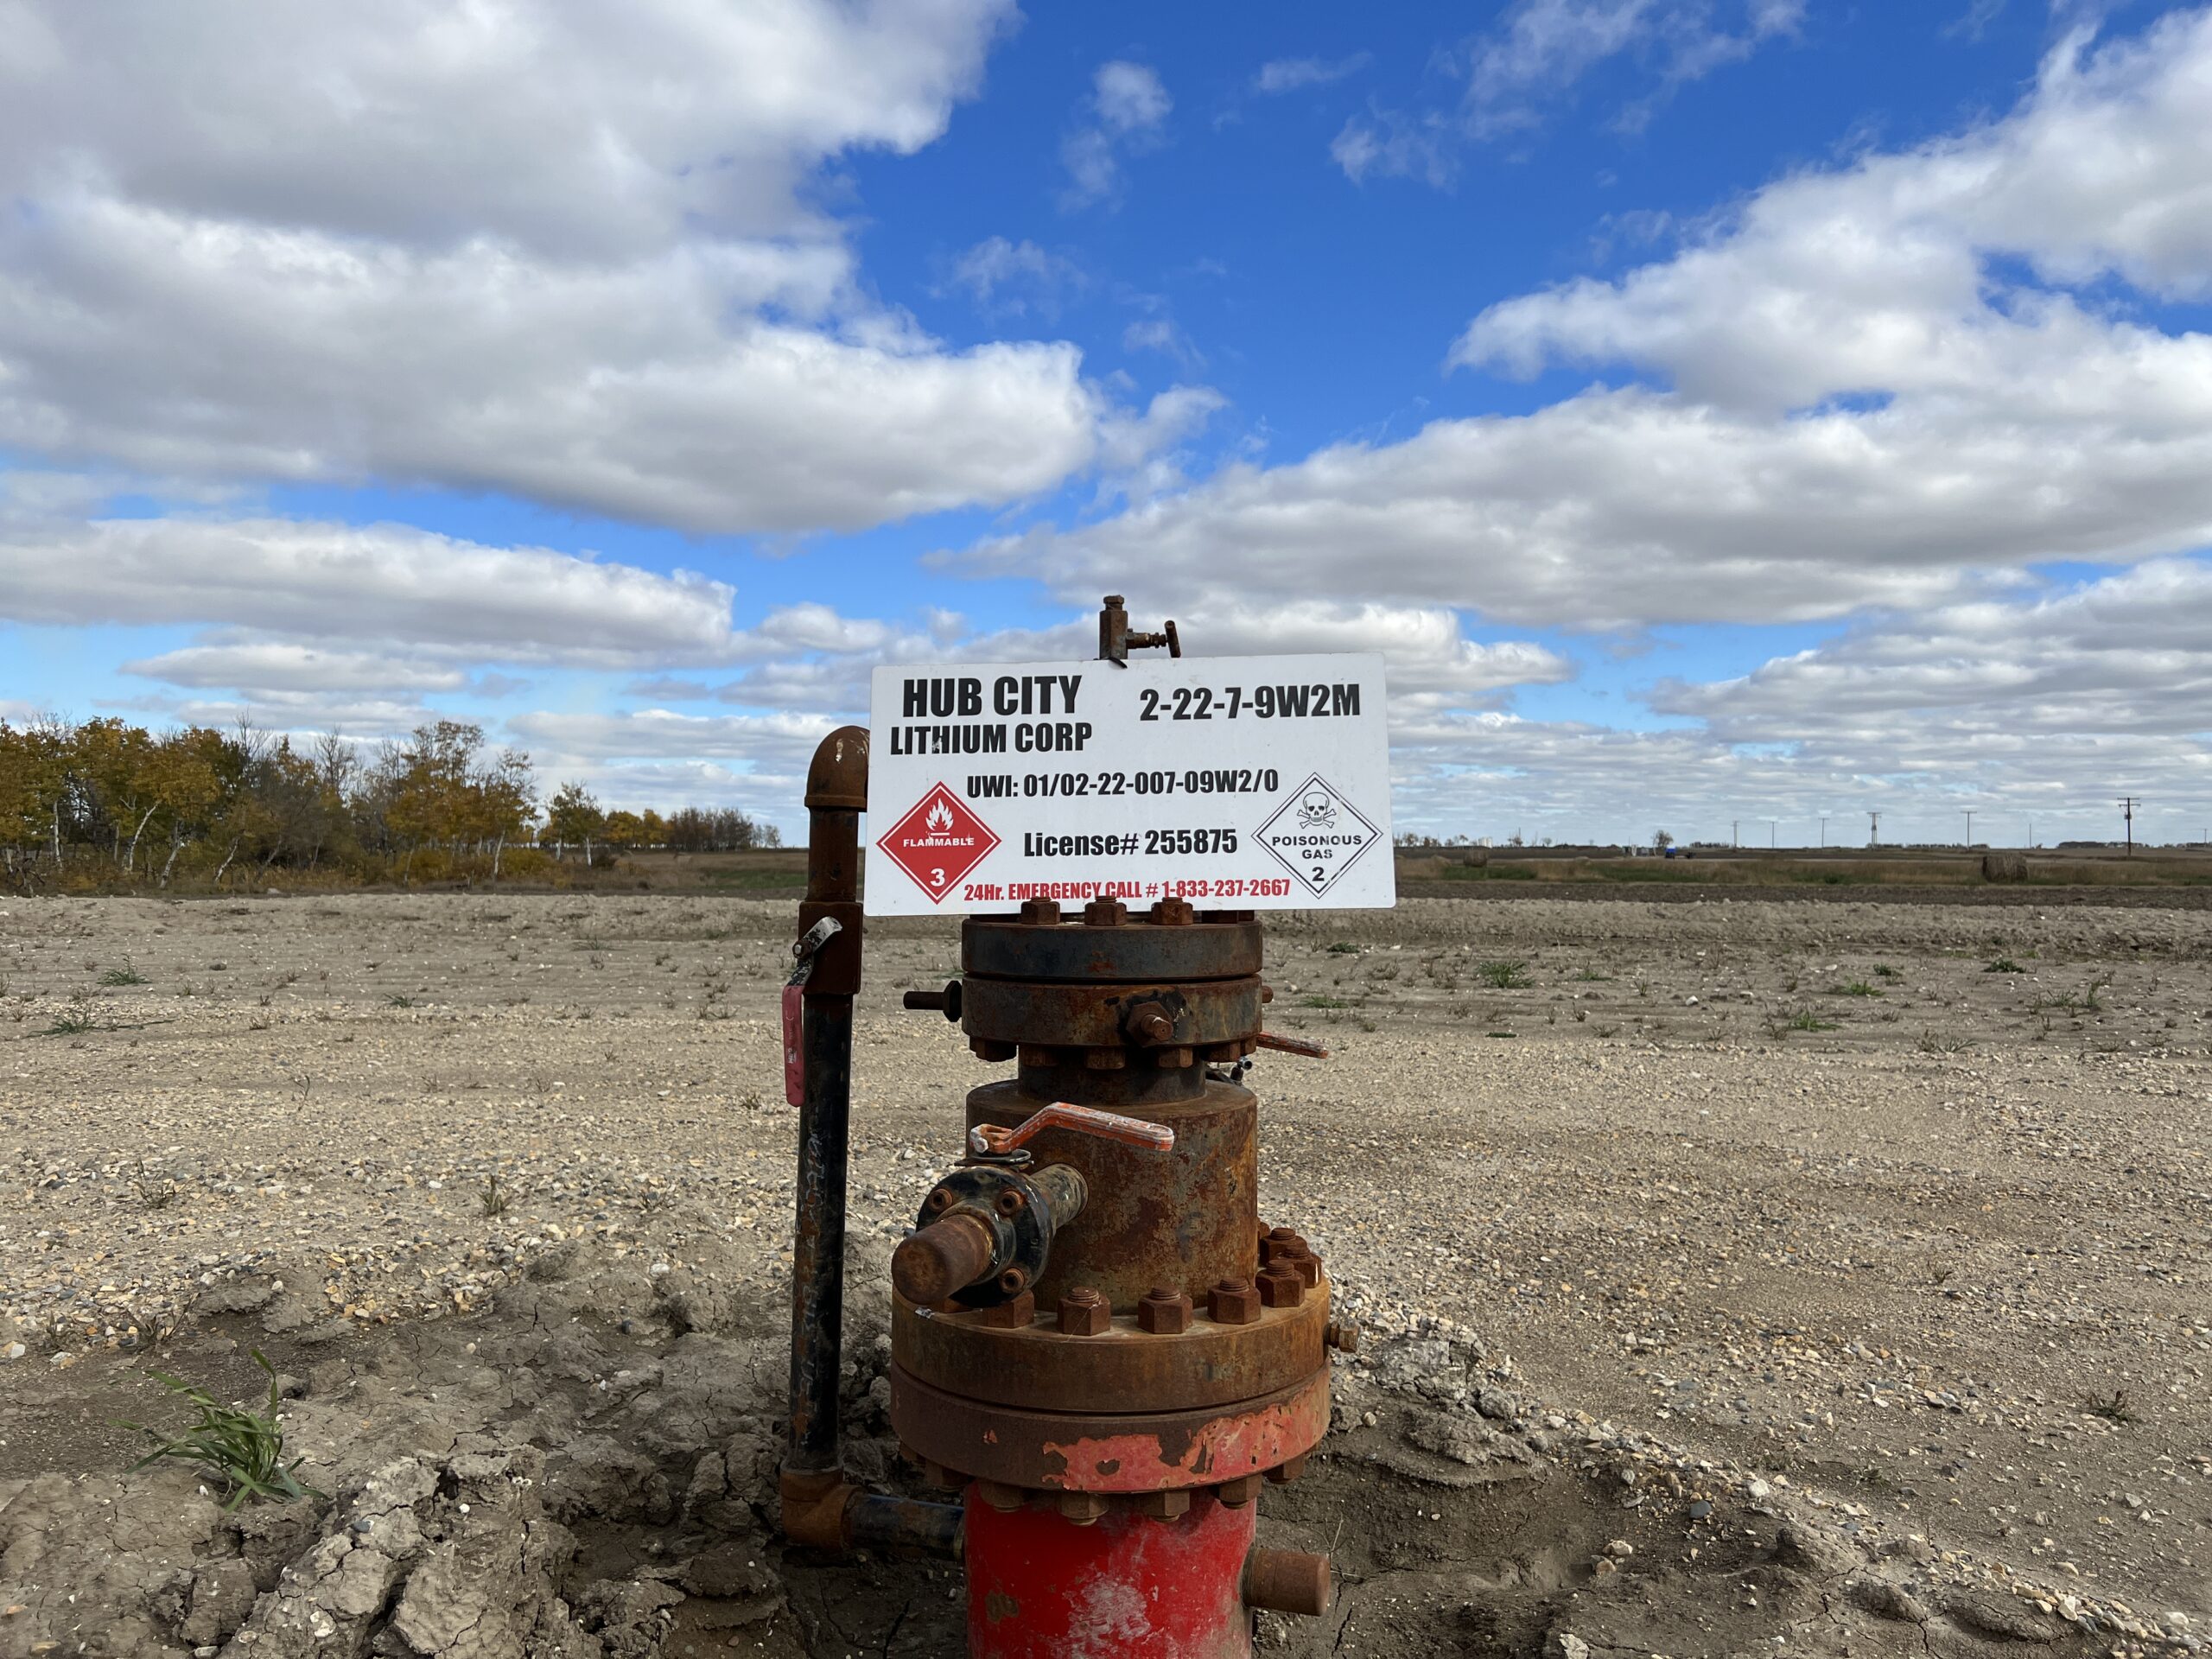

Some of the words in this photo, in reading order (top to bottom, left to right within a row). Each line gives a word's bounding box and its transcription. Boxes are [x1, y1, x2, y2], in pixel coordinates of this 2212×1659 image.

[903, 677, 982, 717] HUB
[994, 675, 1082, 716] CITY
[1140, 683, 1360, 721] 2-22-7-9W2M
[891, 724, 1007, 755] LITHIUM
[1014, 722, 1092, 753] CORP
[967, 775, 1019, 798] UWI:
[1024, 768, 1279, 797] 01/02-22-007-09W2/0
[903, 837, 975, 847] FLAMMABLE
[1024, 832, 1139, 856] License#
[1144, 829, 1237, 855] 255875
[1272, 835, 1362, 846] POISONOUS
[1301, 849, 1332, 859] GAS
[930, 868, 945, 887] 3
[1312, 867, 1325, 881] 2
[964, 884, 1004, 900] 24Hr.
[1008, 881, 1100, 899] EMERGENCY
[1106, 880, 1141, 898] CALL
[1161, 879, 1290, 898] 1-833-237-2667
